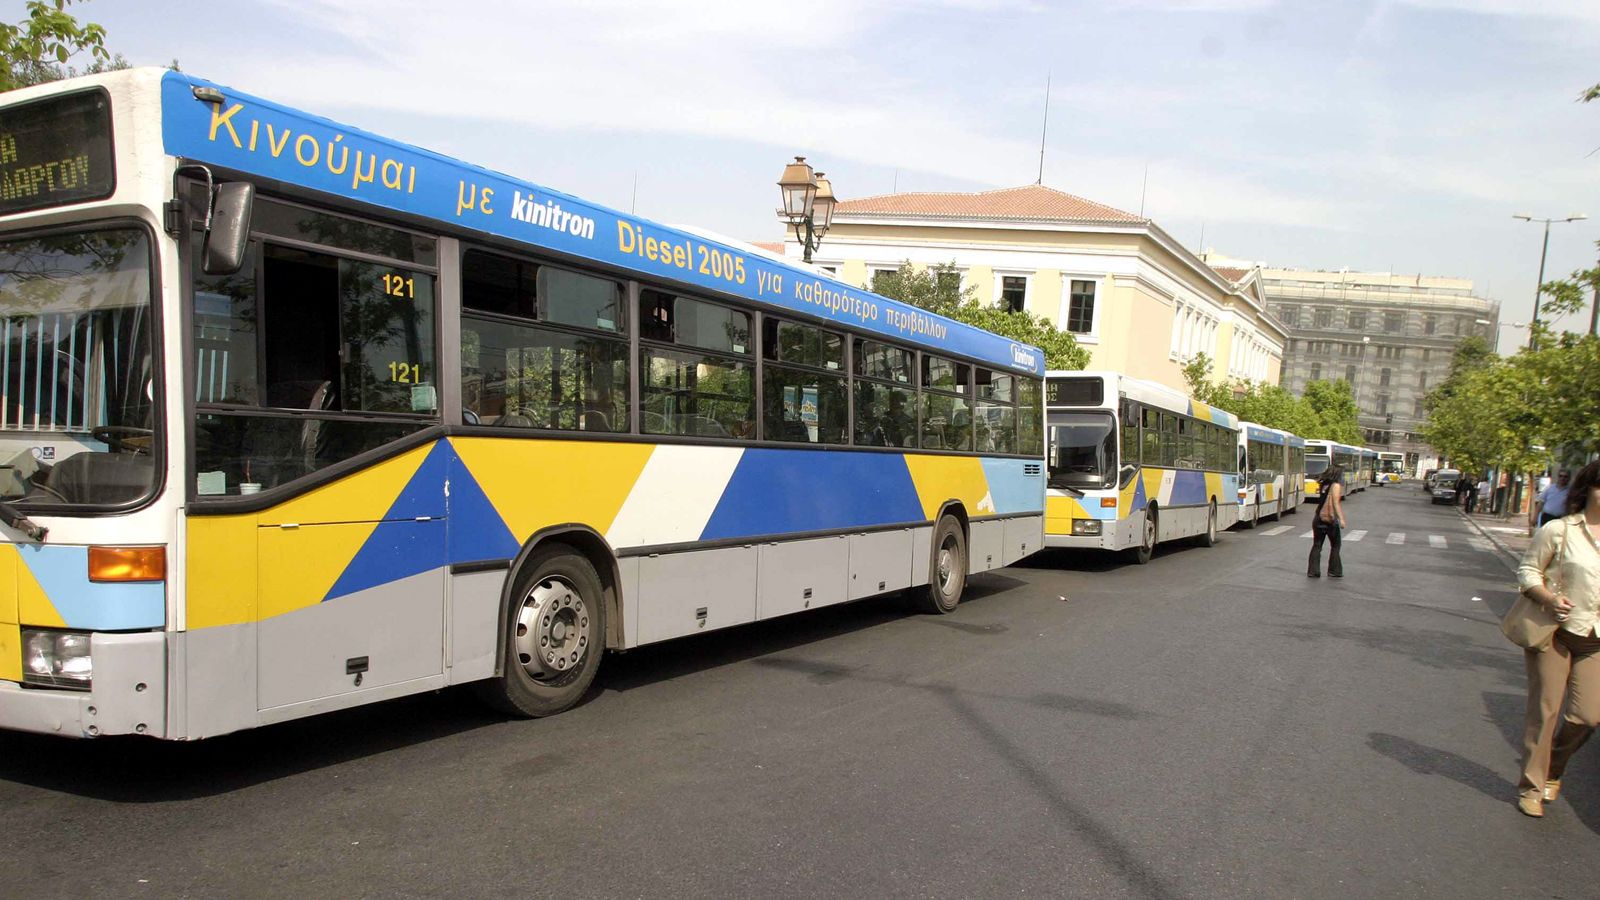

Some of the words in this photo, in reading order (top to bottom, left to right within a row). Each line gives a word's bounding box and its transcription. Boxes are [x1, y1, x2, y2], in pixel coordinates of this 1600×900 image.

[208, 102, 416, 193] Κινούμαι
[456, 180, 495, 216] με
[511, 191, 595, 240] kinitron
[617, 220, 693, 270] Diesel
[698, 246, 746, 284] 2005
[757, 269, 782, 294] για
[795, 279, 878, 320] καθαρότερο
[886, 308, 947, 340] περιβάλλον
[383, 274, 415, 298] 121
[389, 361, 420, 384] 121
